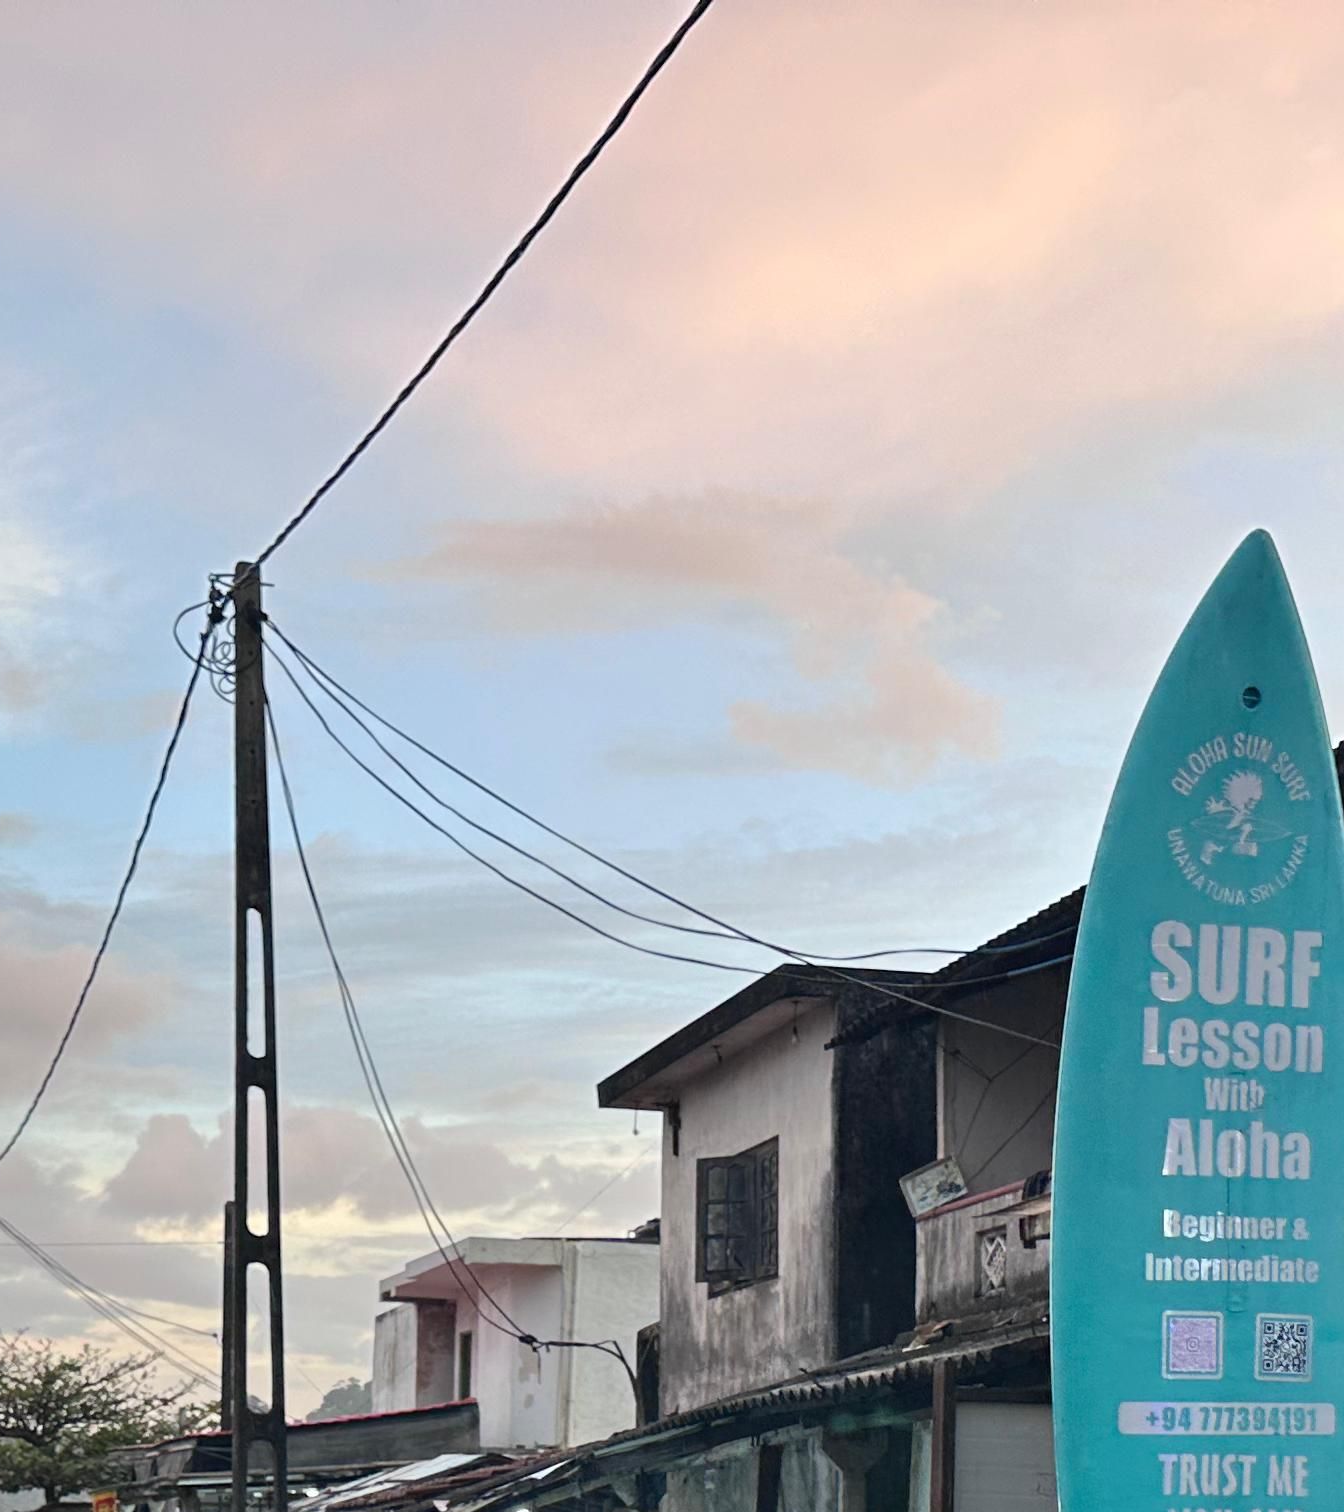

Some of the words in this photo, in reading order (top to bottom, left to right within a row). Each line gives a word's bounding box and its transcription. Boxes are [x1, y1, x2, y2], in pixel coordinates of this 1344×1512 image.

[1171, 736, 1229, 796] ALOHA
[1233, 732, 1273, 762] SUN
[1271, 751, 1311, 801] SURF
[1249, 882, 1274, 904] SRI
[1275, 834, 1309, 889] LANKA
[1150, 919, 1324, 1009] SURF
[1142, 1006, 1324, 1073] Lesson
[1203, 1076, 1266, 1112] With
[1161, 1117, 1312, 1181] Aloha
[1163, 1208, 1287, 1243] Beginner
[1291, 1217, 1311, 1241] &
[1145, 1252, 1321, 1284] Intermediate
[1145, 1406, 1193, 1432] +94
[1199, 1406, 1318, 1434] 777394191
[1158, 1452, 1257, 1498] TRUST
[1267, 1454, 1309, 1498] ME
